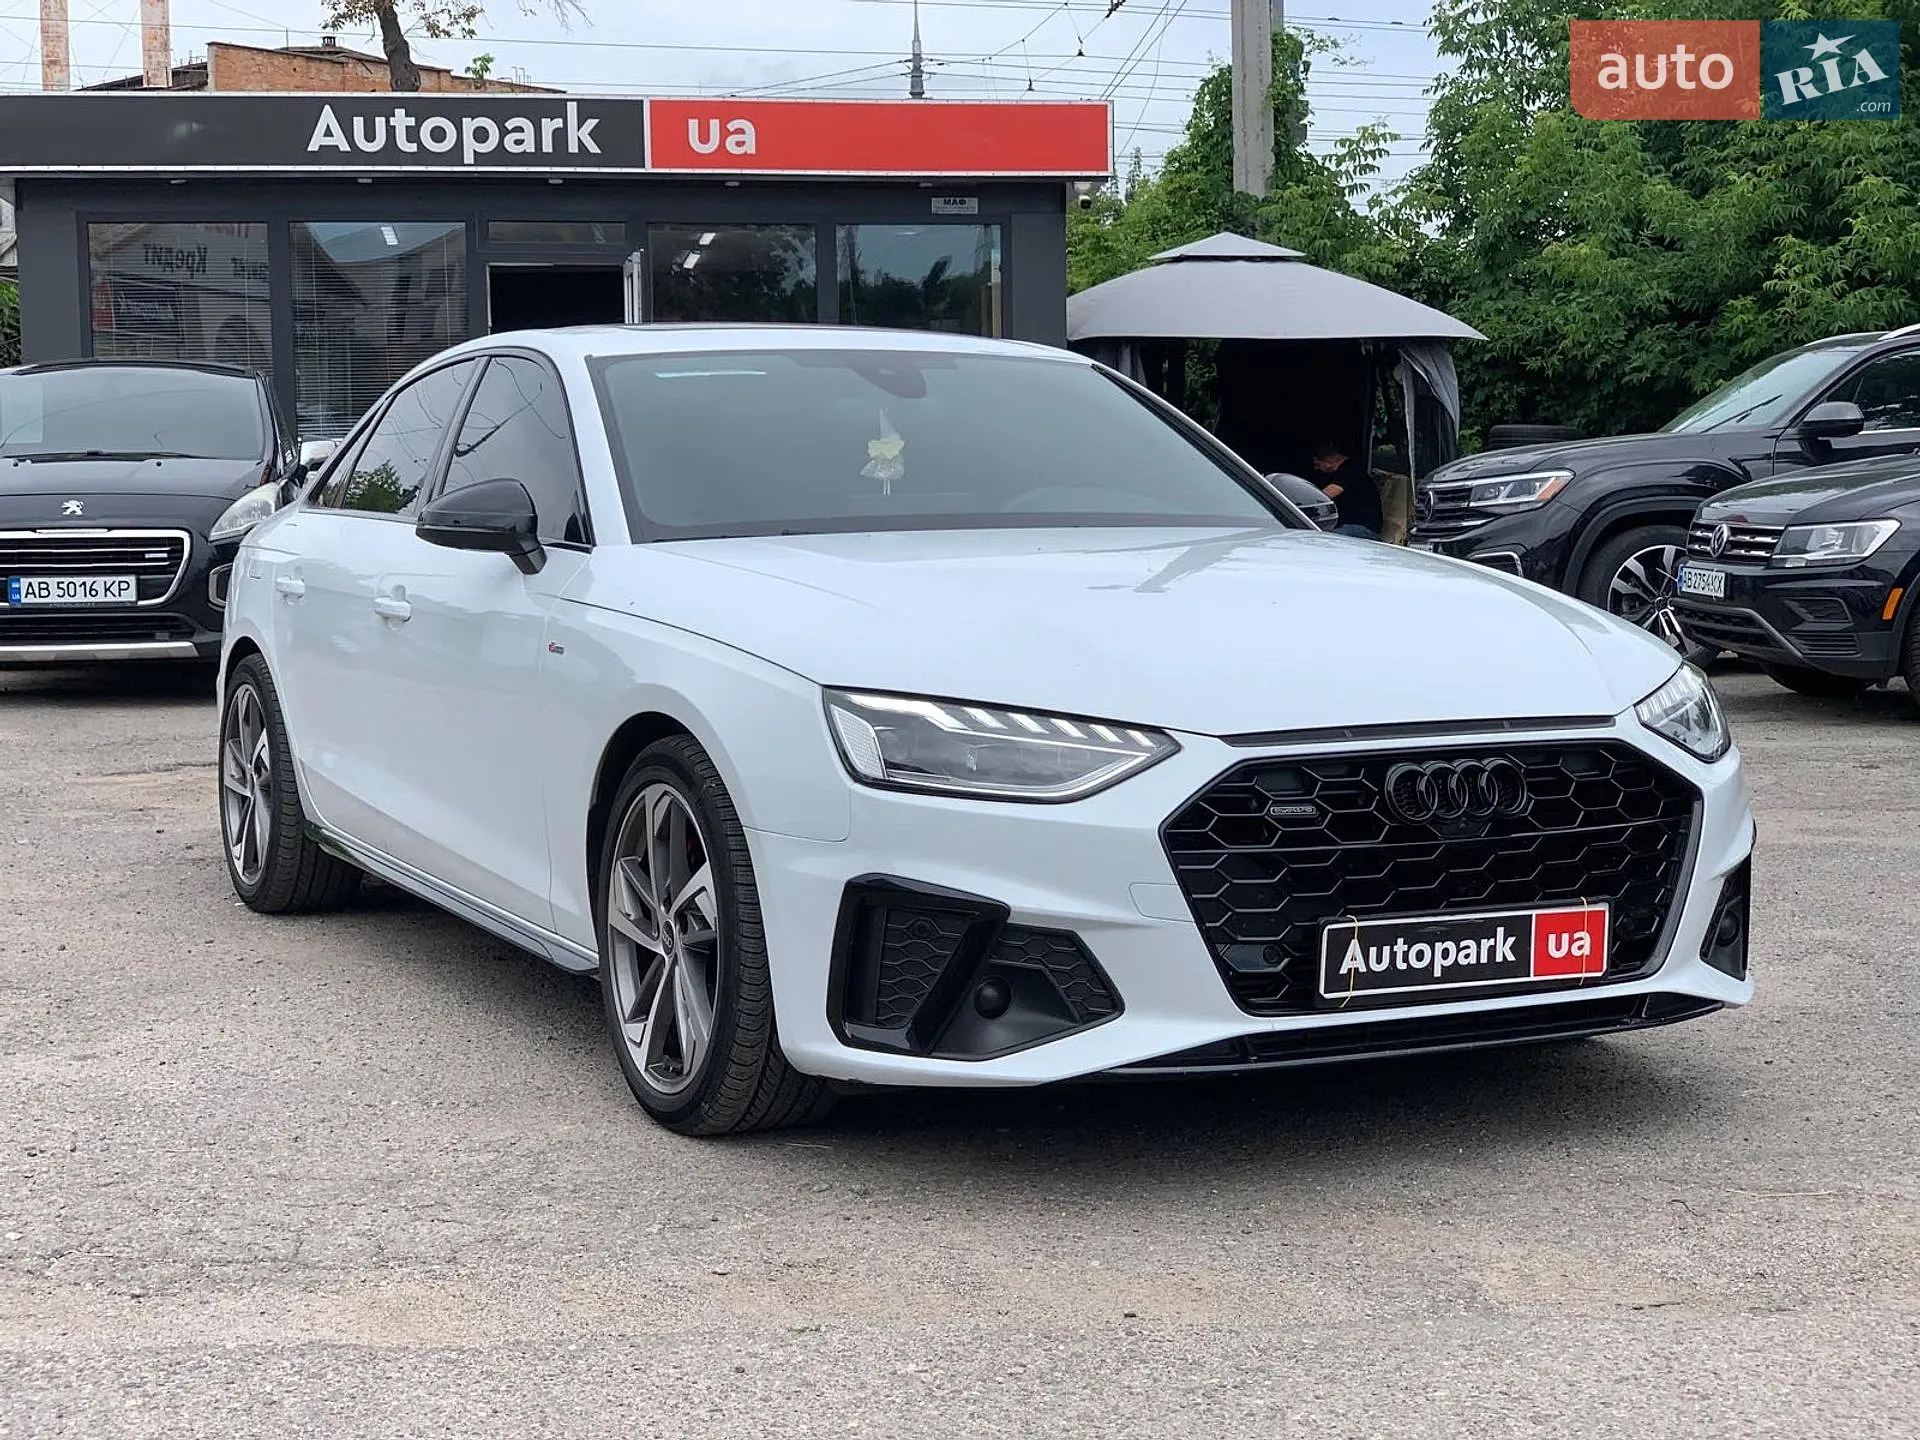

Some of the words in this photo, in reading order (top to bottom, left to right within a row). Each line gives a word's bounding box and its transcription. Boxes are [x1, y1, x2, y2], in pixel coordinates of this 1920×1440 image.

[307, 101, 601, 164] Autopark
[687, 117, 757, 155] ua
[24, 581, 51, 599] AB
[56, 580, 99, 599] 5016
[104, 580, 131, 598] KP
[1339, 926, 1517, 978] Autopark
[1547, 930, 1592, 959] ua
